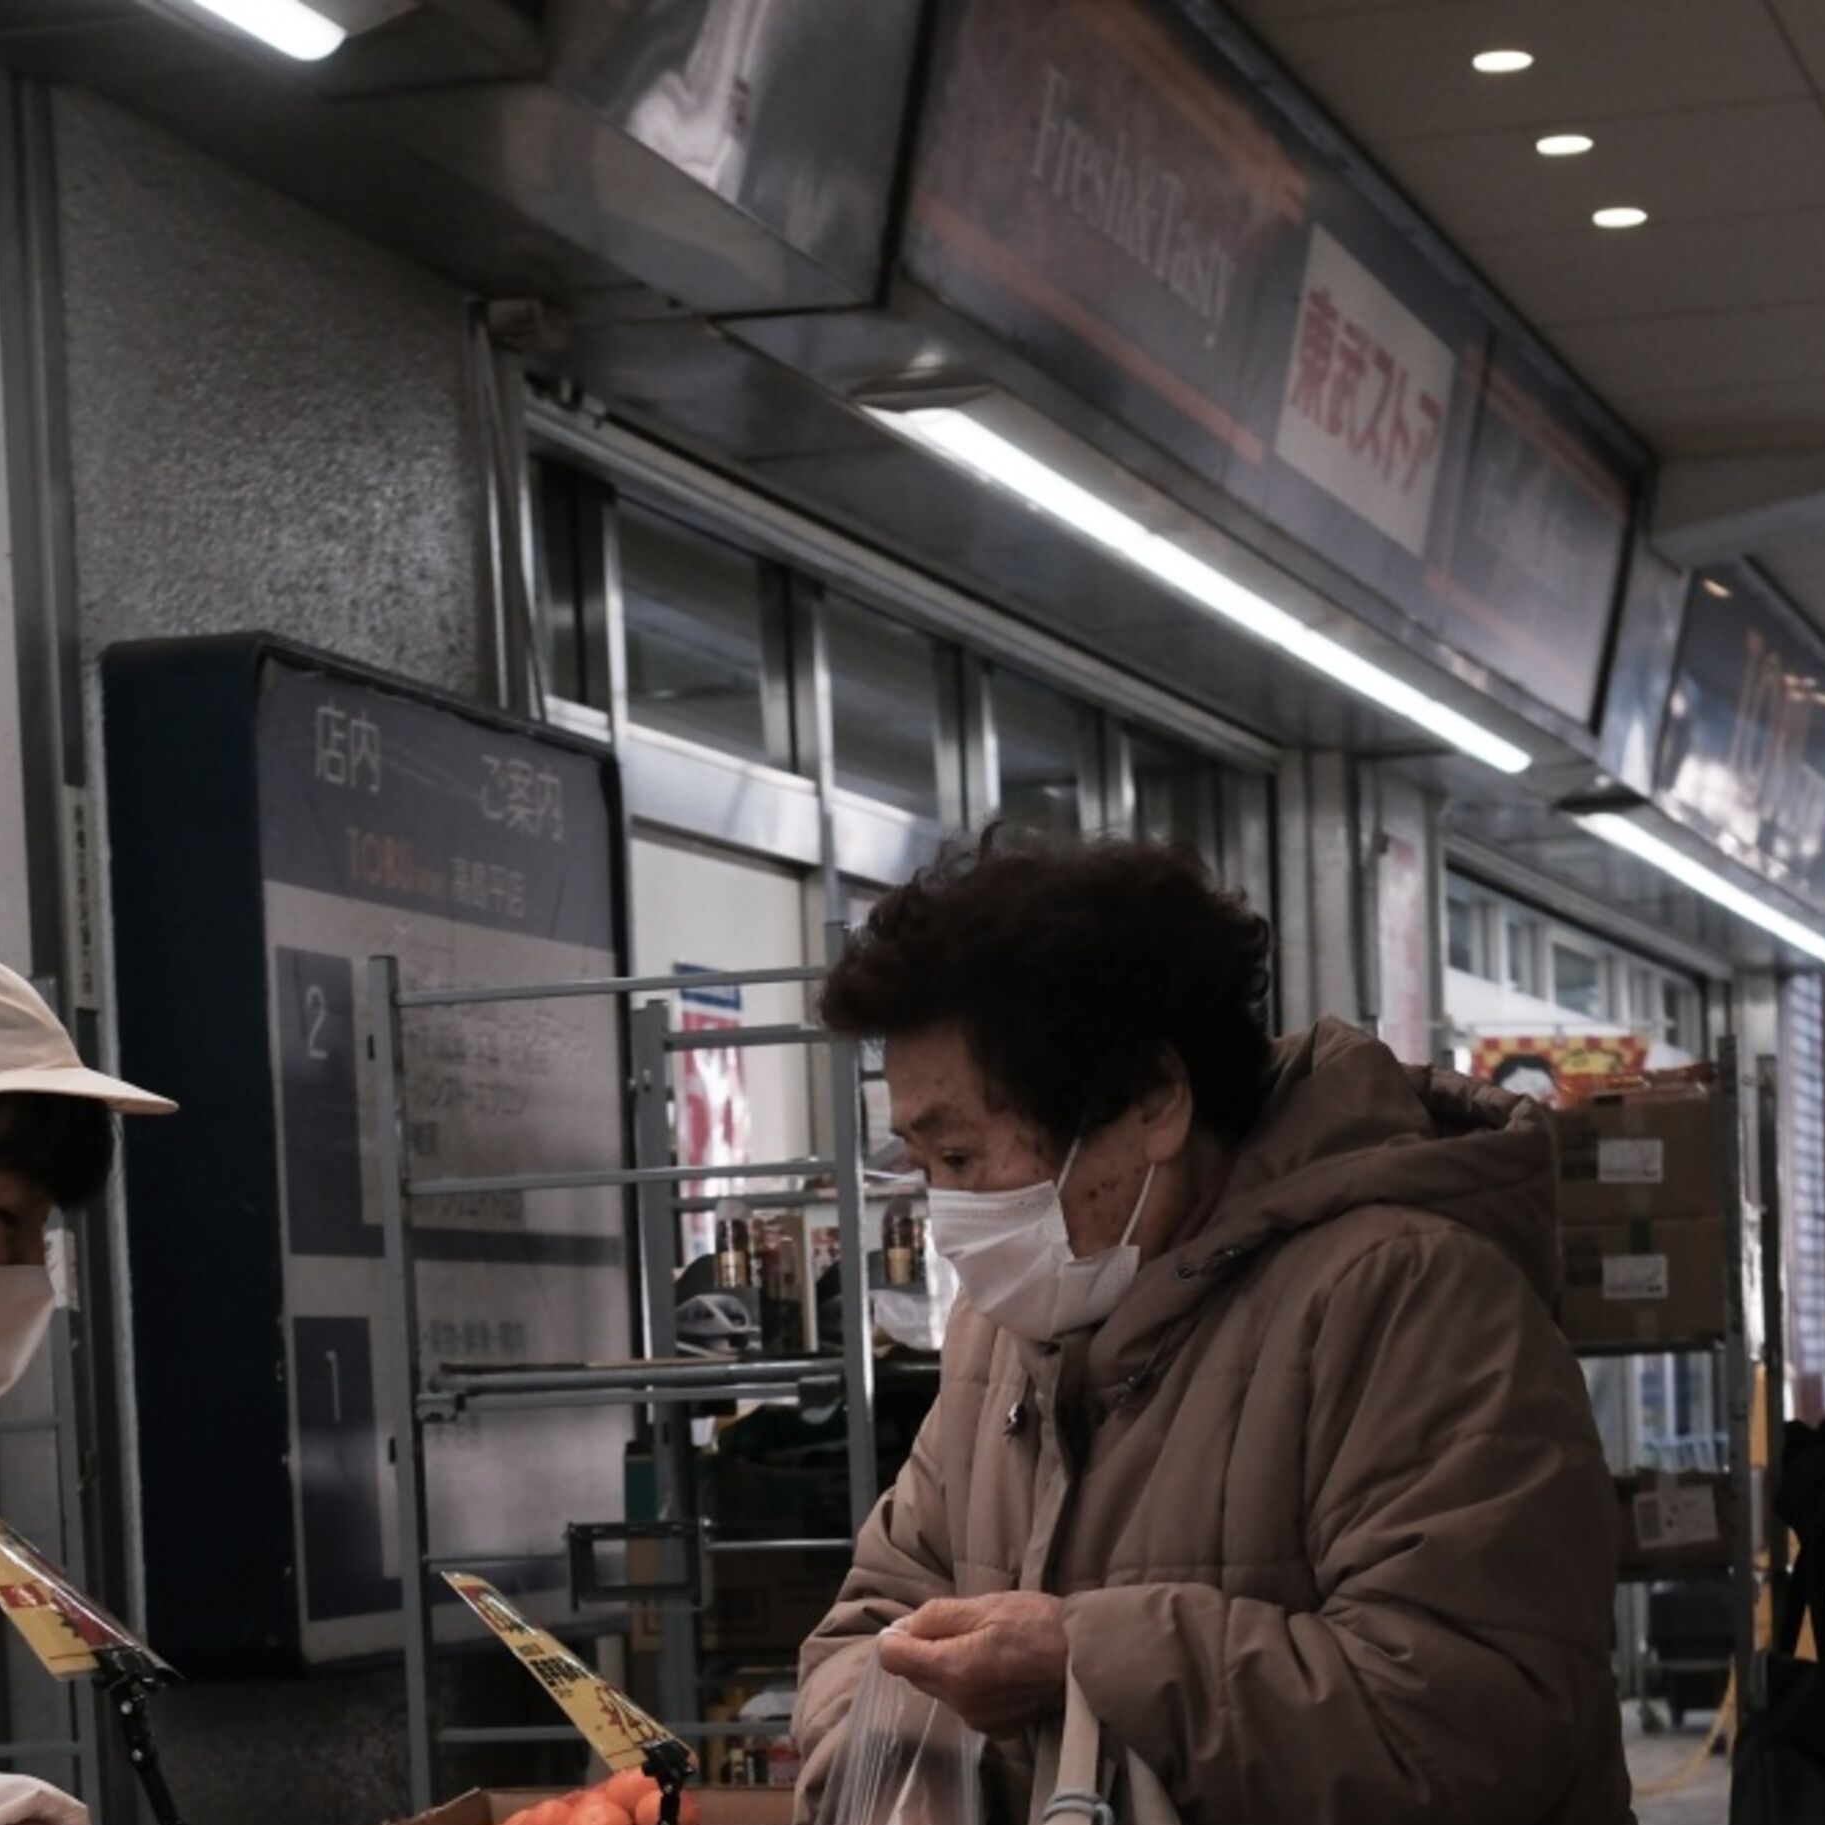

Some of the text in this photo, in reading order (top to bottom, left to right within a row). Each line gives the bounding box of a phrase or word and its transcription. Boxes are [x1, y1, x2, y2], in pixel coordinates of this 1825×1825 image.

[1291, 285, 1444, 492] 東武ストア
[313, 703, 565, 842] 店内 ご案内
[305, 984, 328, 1061] 2
[325, 1348, 342, 1423] 1
